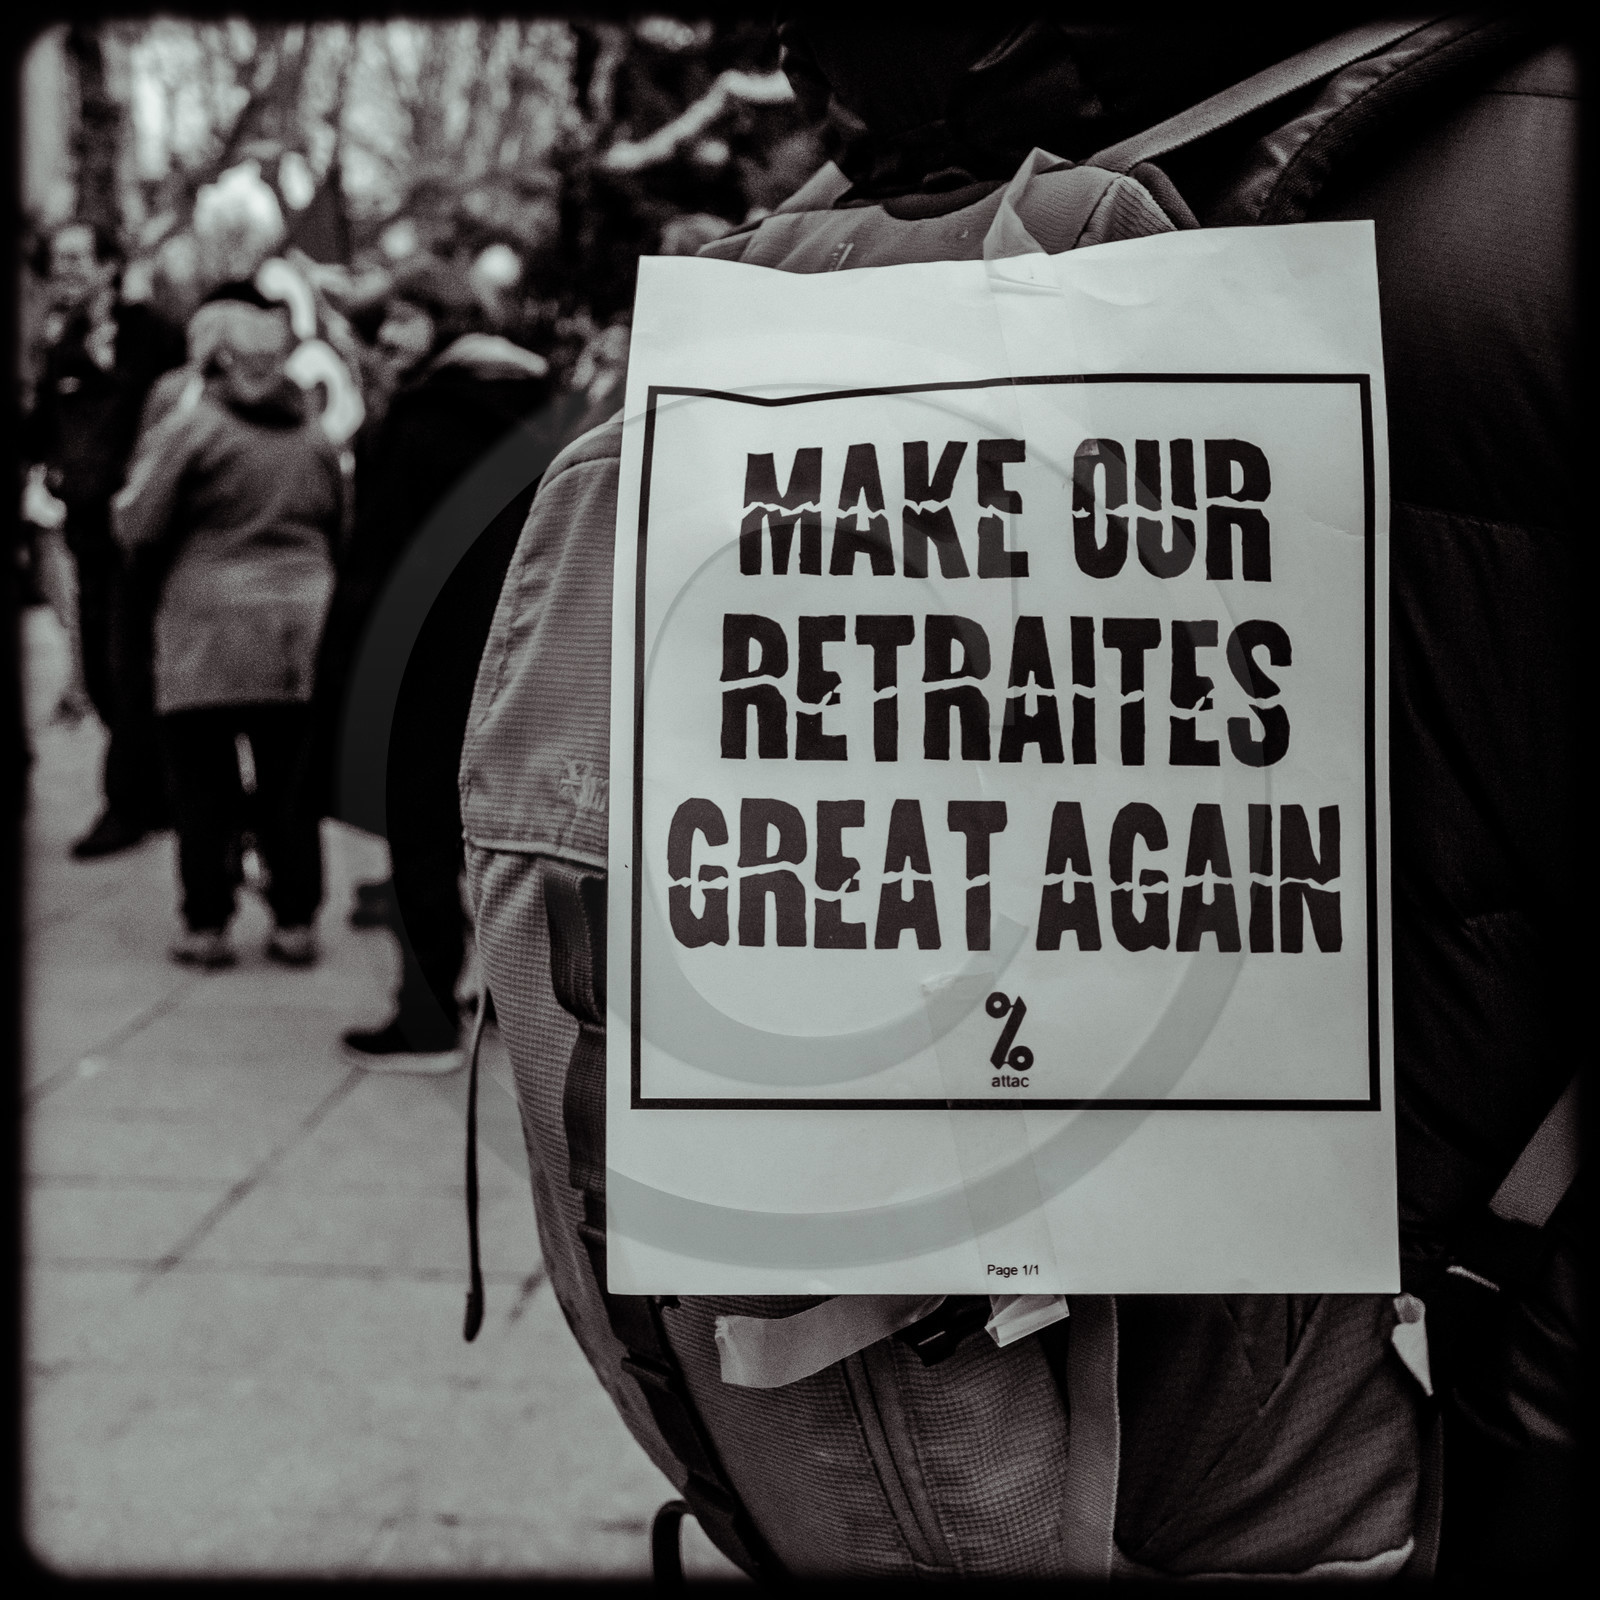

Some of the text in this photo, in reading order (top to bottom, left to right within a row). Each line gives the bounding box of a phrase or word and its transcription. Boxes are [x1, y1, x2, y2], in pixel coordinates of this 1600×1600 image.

[740, 438, 1271, 582] MAKE OUR
[720, 614, 1292, 768] RETRAITES
[667, 798, 1343, 954] GREAT AGAIN
[991, 1074, 1030, 1088] attac
[987, 1264, 1040, 1279] Page 1/1
